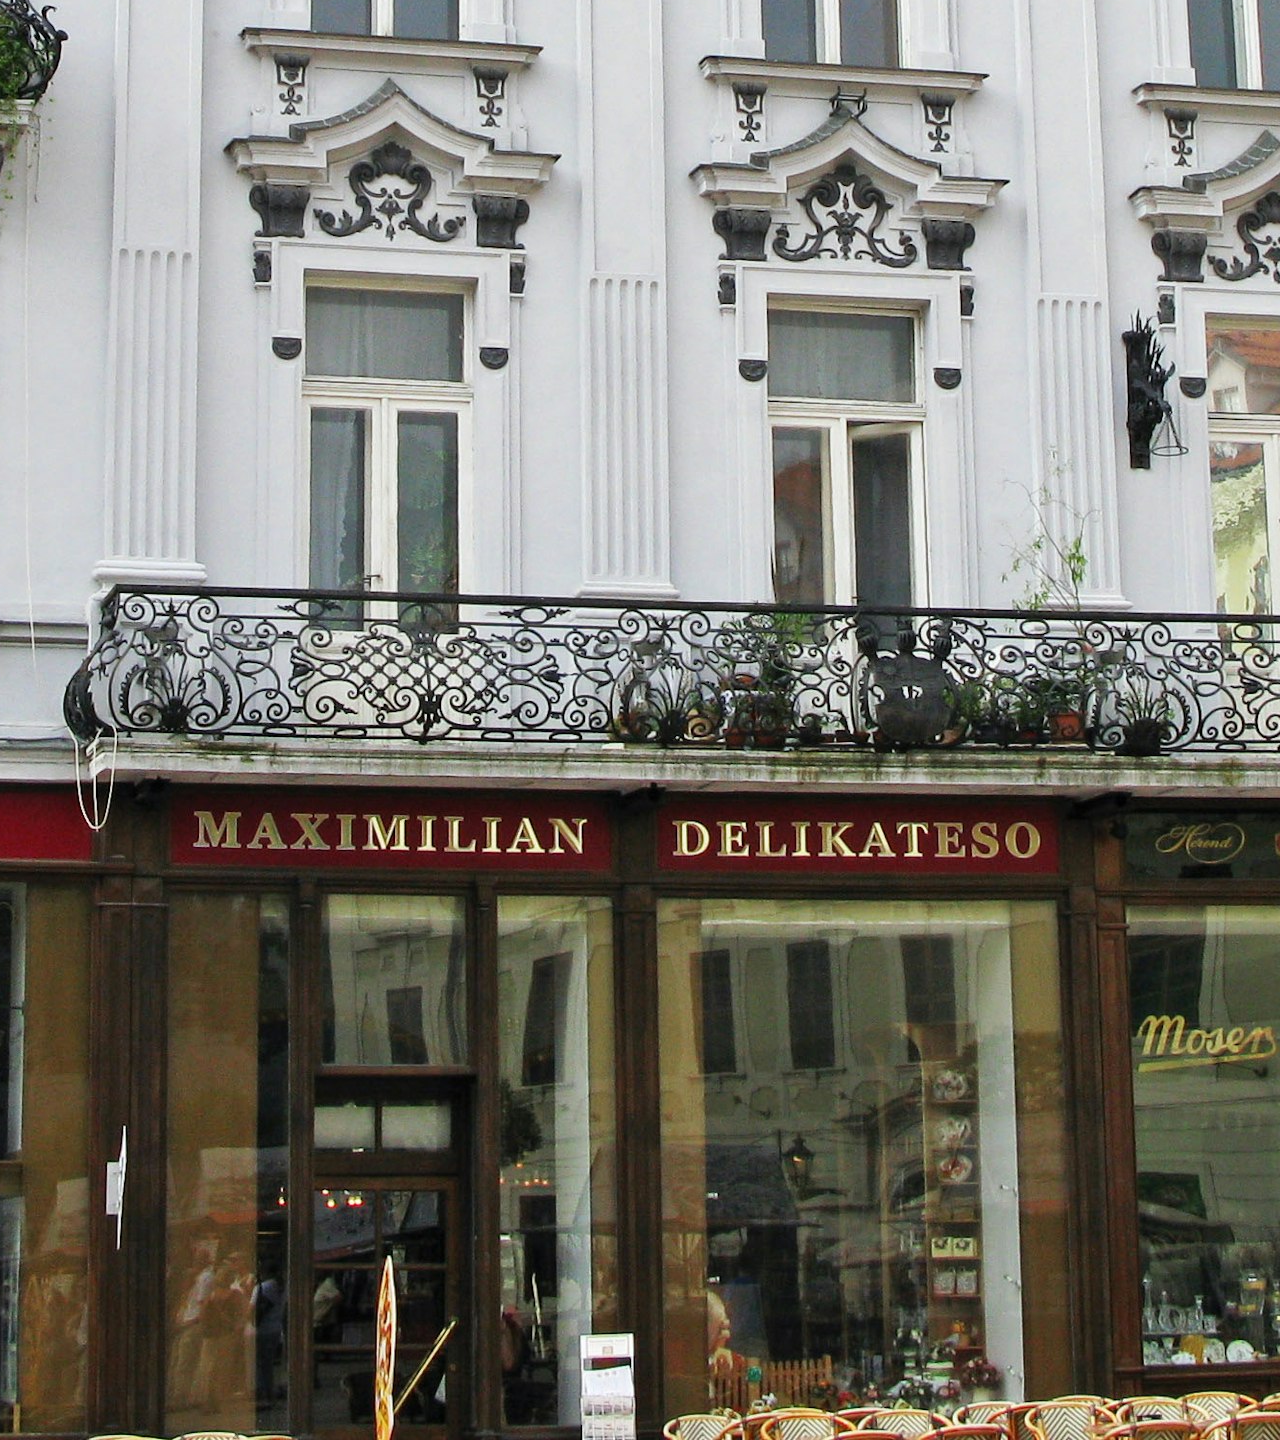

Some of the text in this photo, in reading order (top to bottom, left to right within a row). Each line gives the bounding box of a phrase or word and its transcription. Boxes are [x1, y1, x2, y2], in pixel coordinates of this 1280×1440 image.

[193, 810, 588, 854] MAXIMILIAN
[671, 820, 1041, 859] DELIKATESO
[1136, 1014, 1277, 1072] Moser
